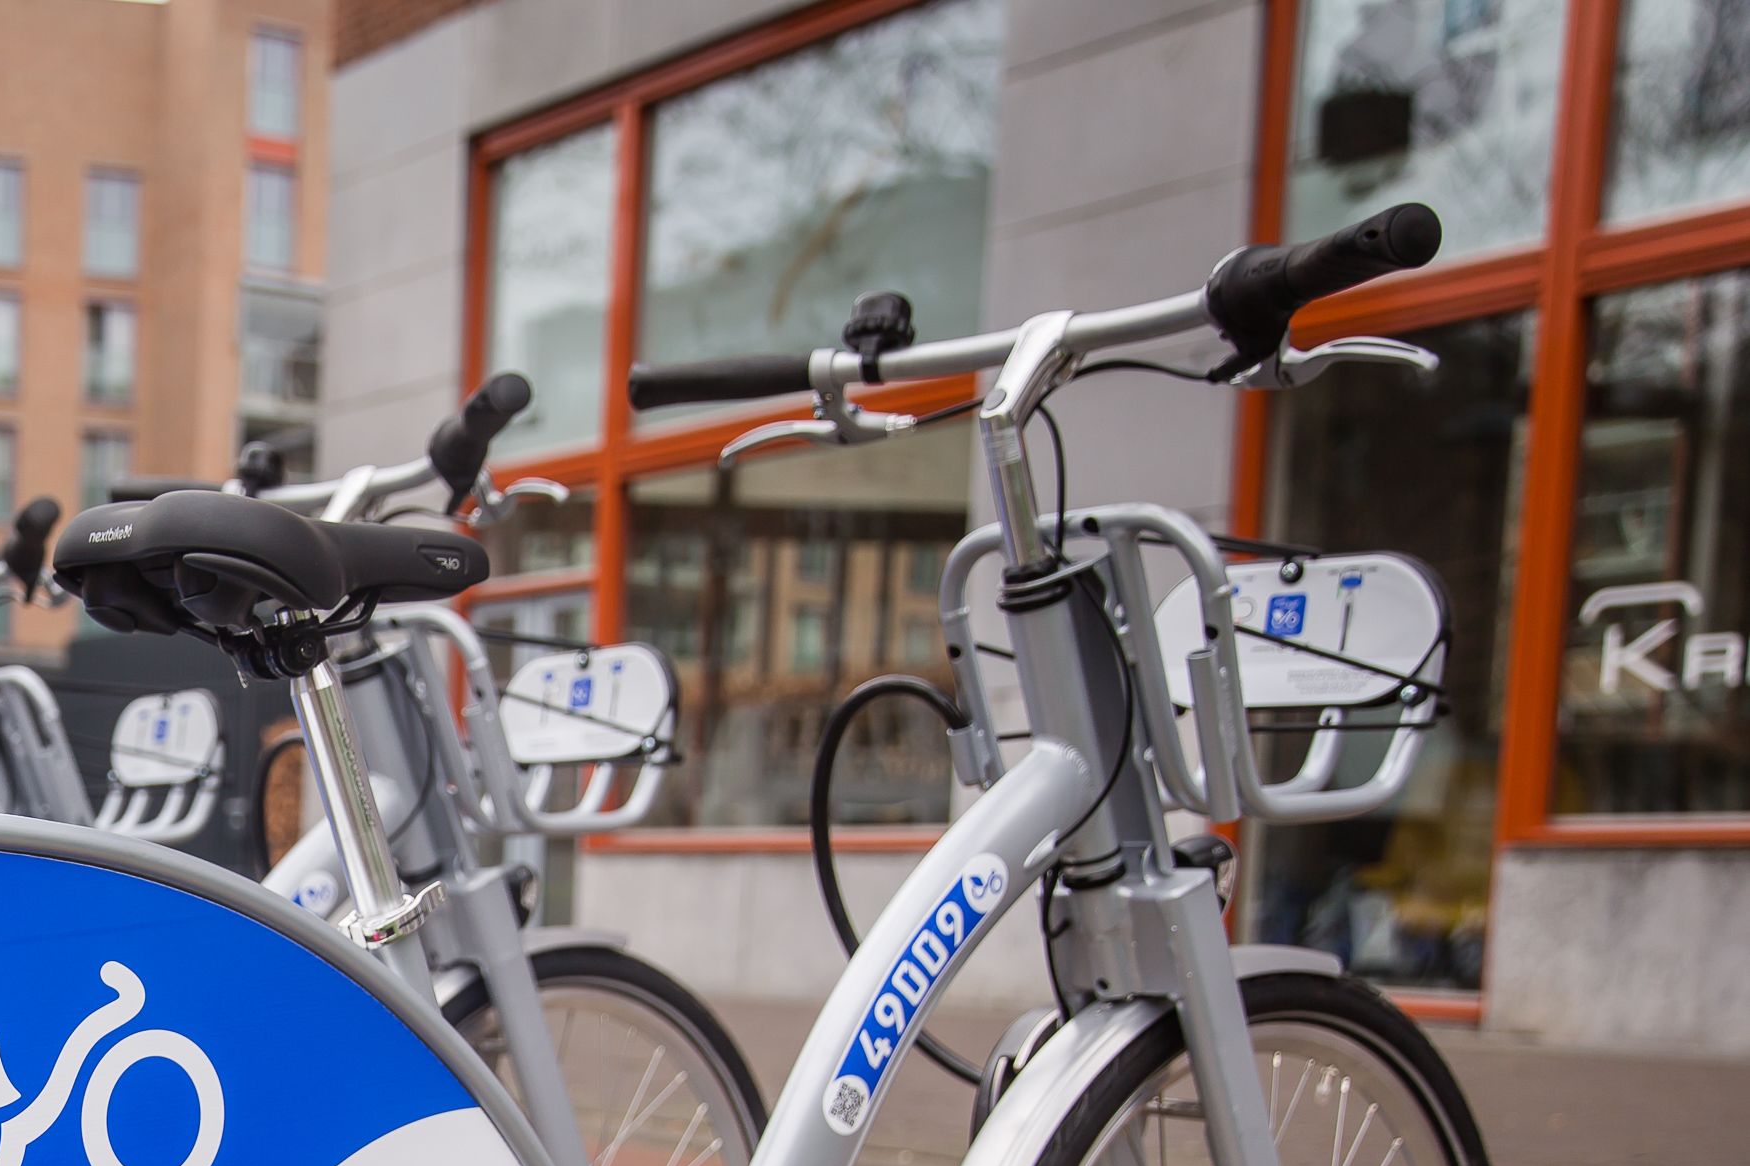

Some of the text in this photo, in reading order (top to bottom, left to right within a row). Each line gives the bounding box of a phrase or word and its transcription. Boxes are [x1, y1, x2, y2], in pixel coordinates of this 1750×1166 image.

[88, 525, 124, 543] nextbike
[1601, 617, 1750, 694] KA
[858, 900, 965, 1071] 49009
